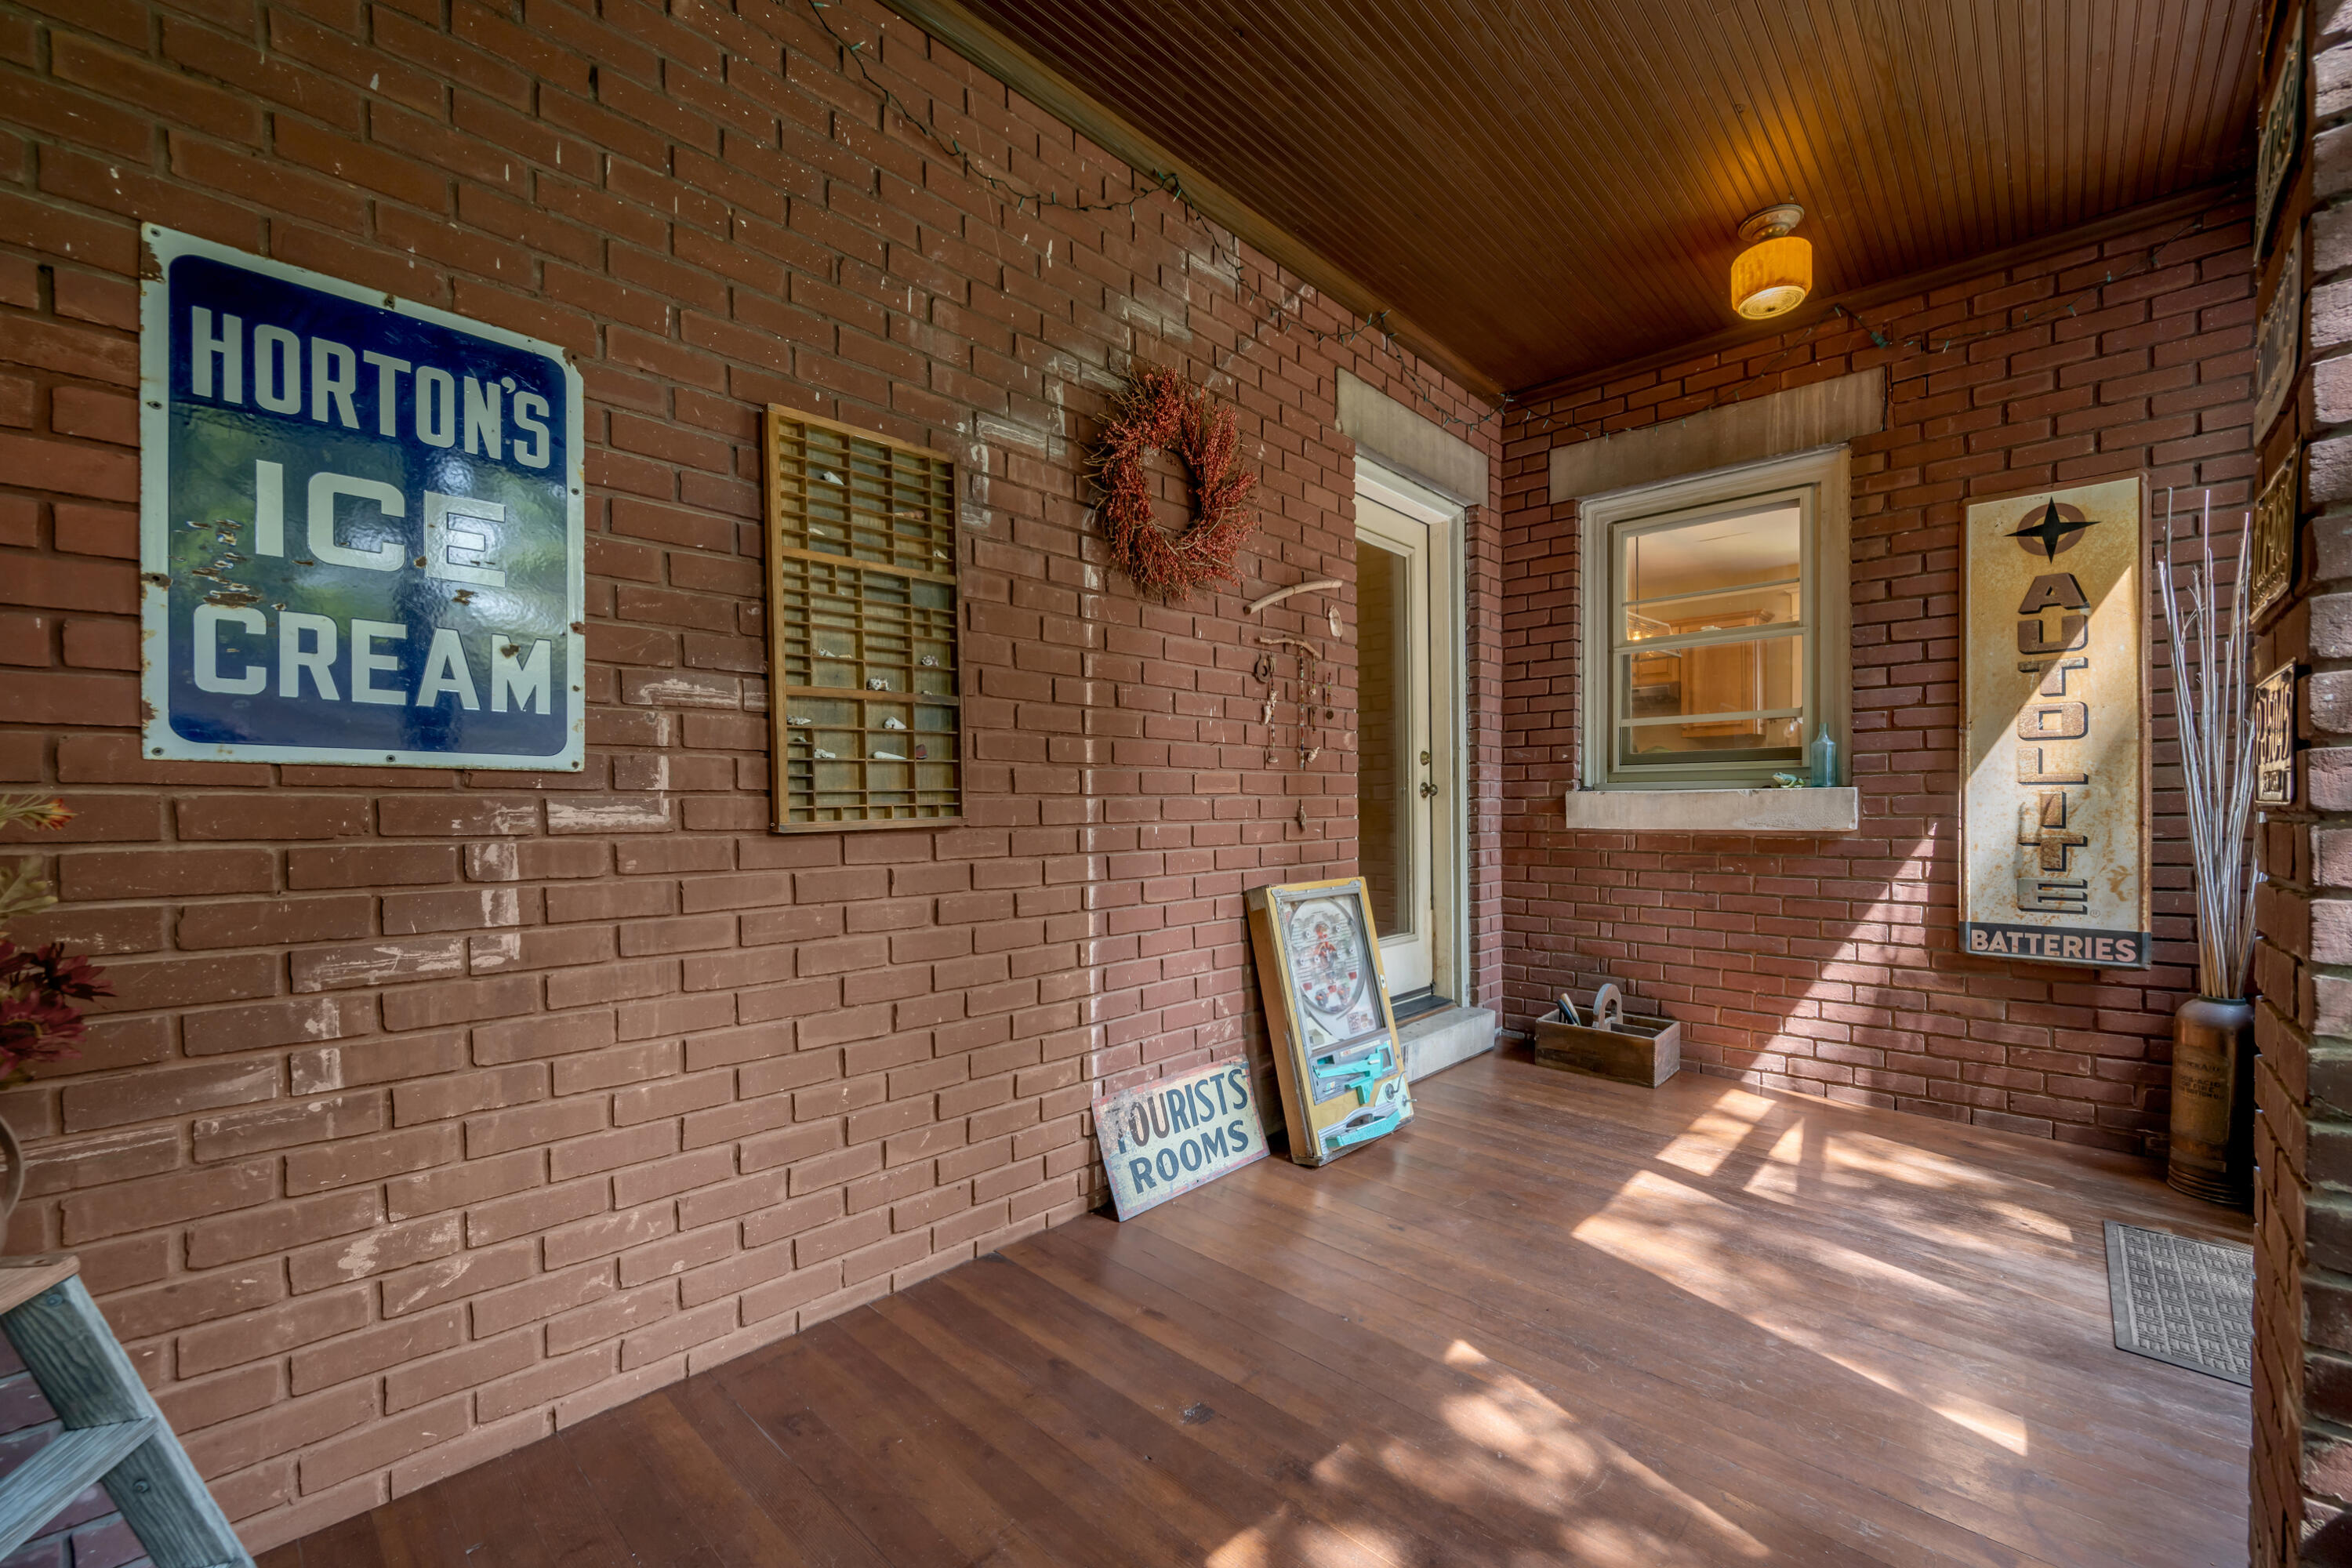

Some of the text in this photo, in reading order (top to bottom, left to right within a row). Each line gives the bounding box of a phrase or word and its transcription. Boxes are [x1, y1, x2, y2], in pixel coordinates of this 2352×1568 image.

[191, 305, 550, 470] HORTON'S
[255, 459, 507, 588] ICE
[192, 603, 552, 715] CREAM
[2017, 572, 2090, 915] AUTOLITE
[1971, 929, 2136, 963] BATTERIES
[1129, 1120, 1249, 1194] ROOMS
